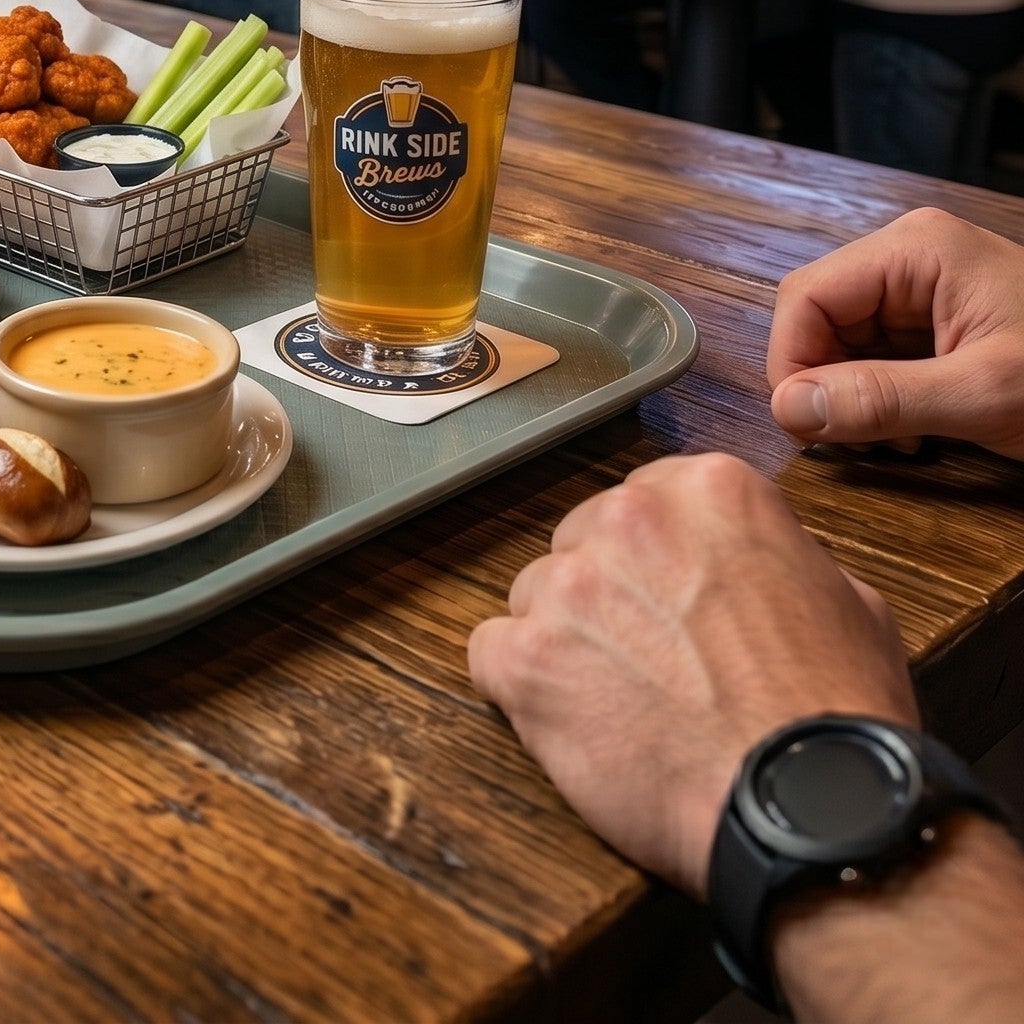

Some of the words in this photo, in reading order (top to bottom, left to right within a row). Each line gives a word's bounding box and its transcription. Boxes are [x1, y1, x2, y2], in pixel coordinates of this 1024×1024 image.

[342, 126, 398, 158] RINK
[406, 130, 462, 158] SIDE
[353, 157, 447, 188] Brews
